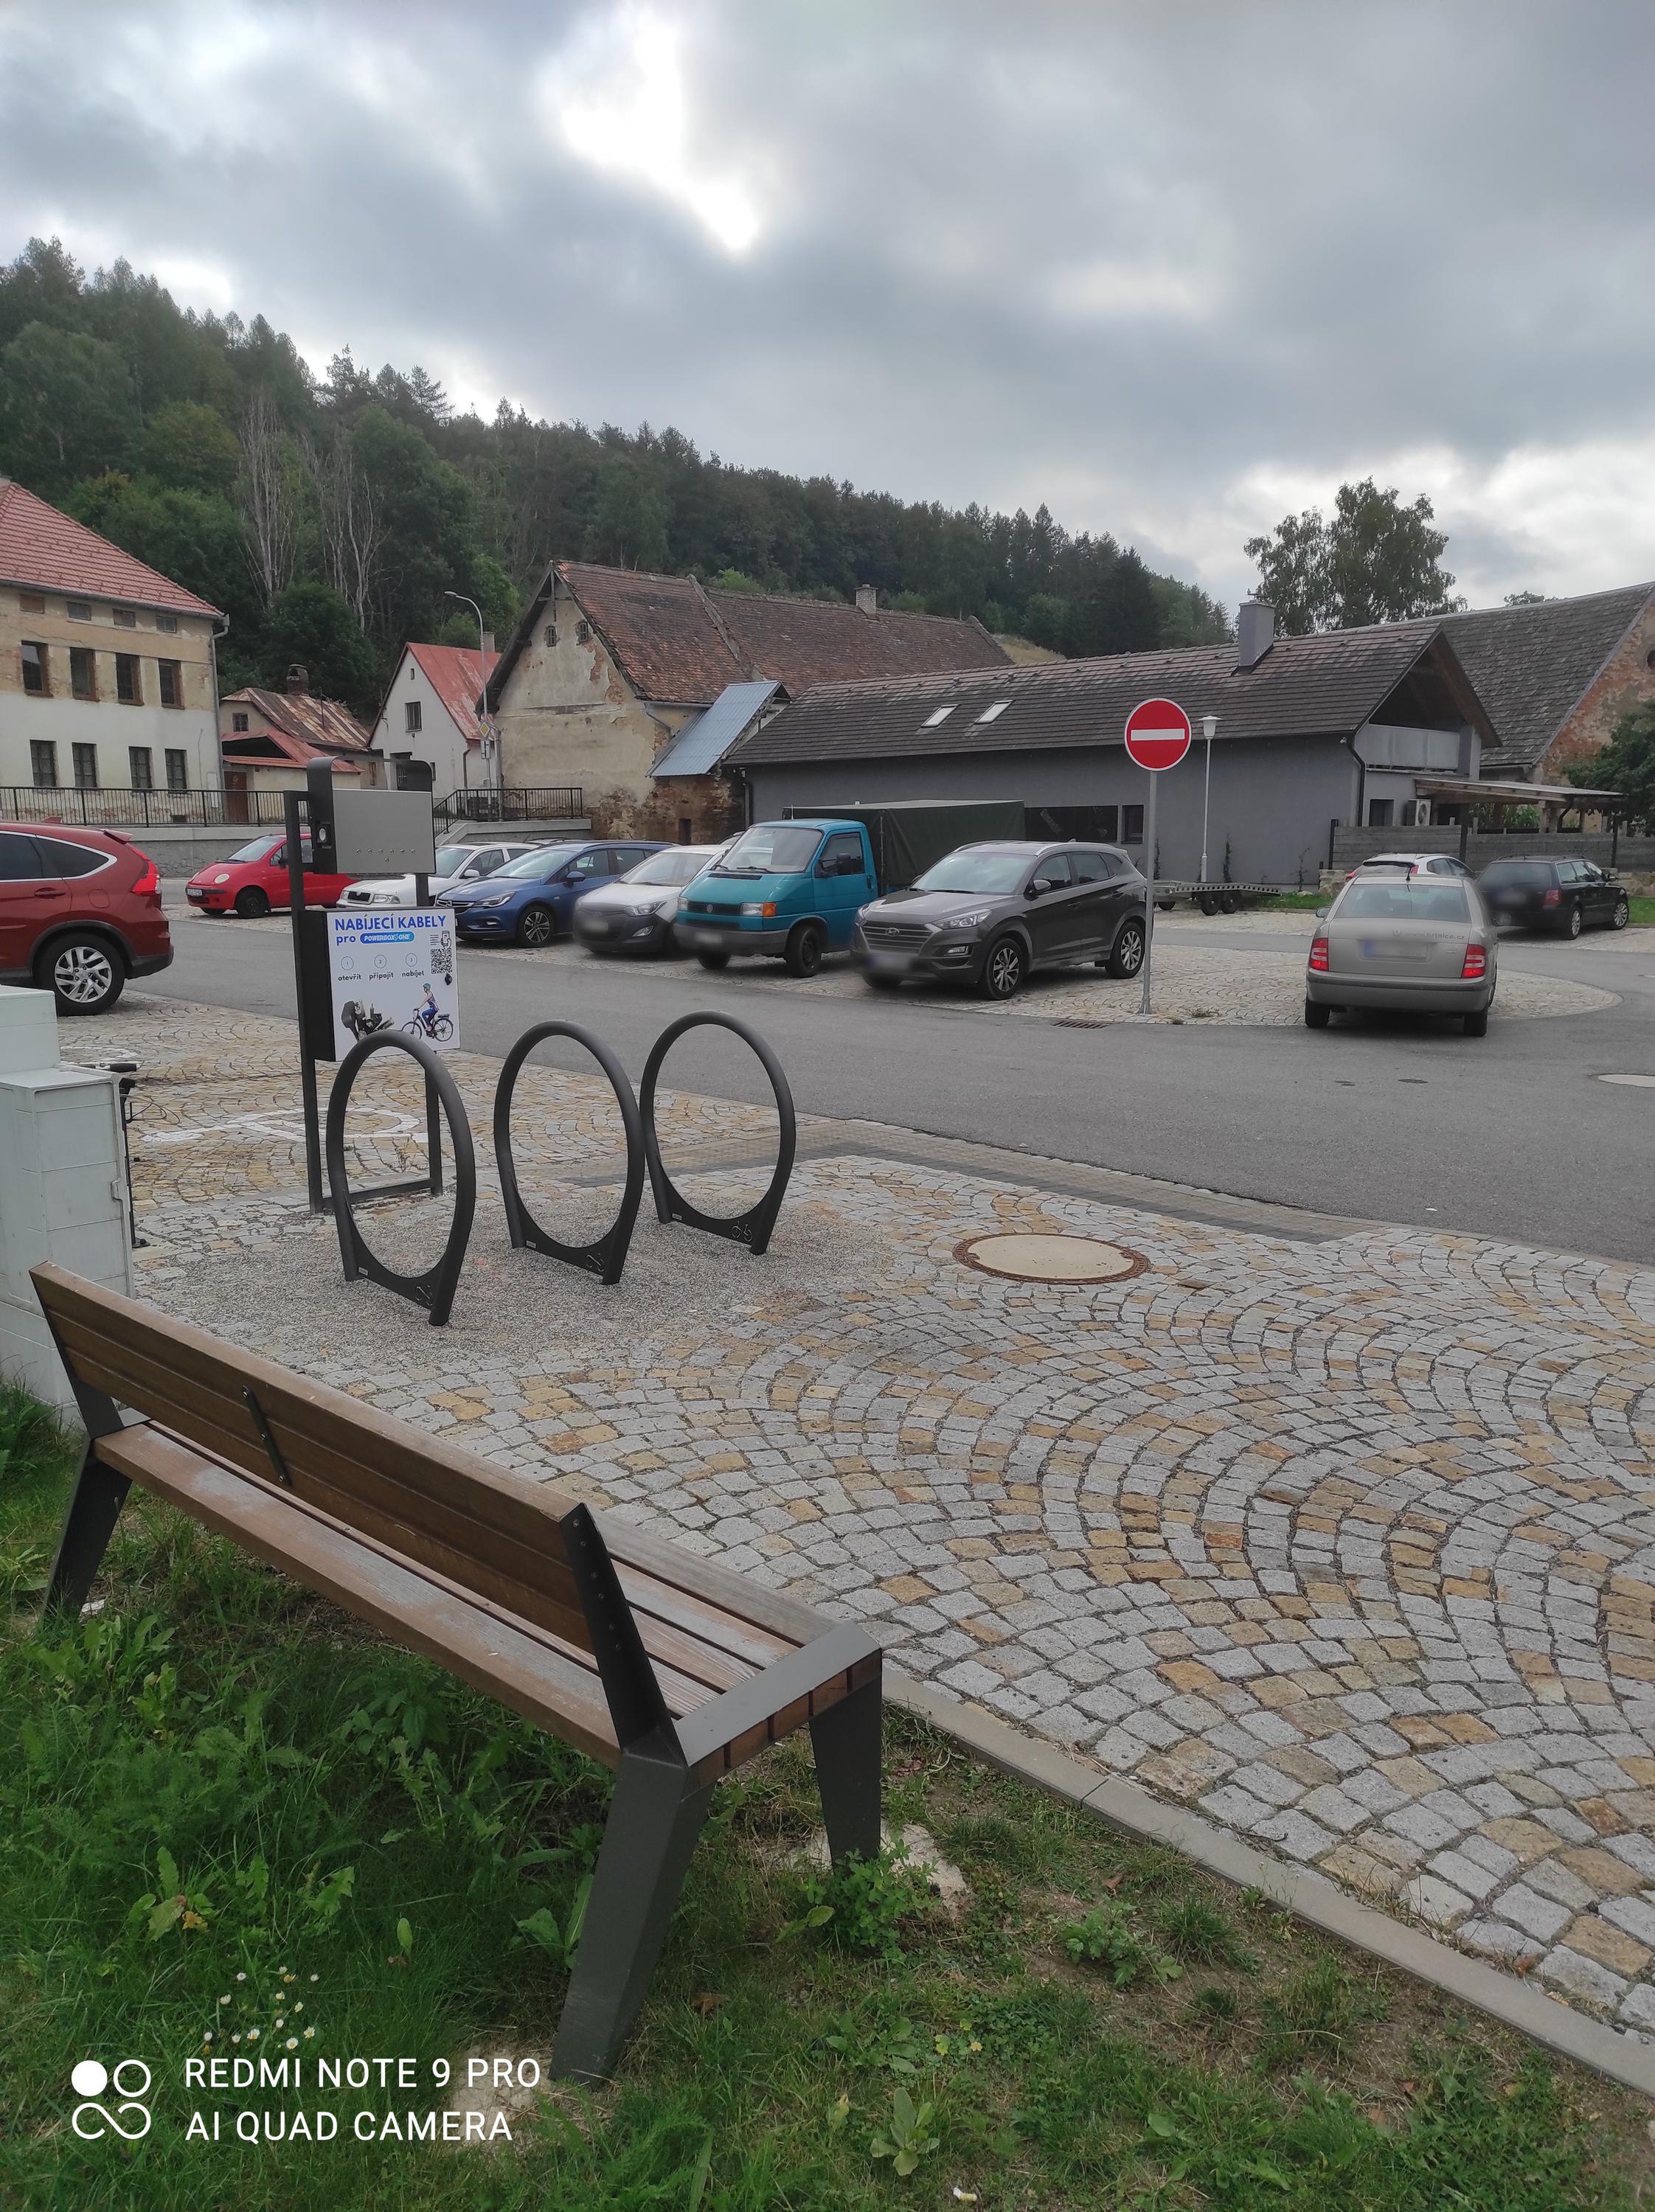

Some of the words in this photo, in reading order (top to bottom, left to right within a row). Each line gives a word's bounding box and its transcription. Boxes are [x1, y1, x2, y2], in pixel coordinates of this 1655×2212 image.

[335, 913, 394, 931] NABÍJECÍ
[398, 915, 447, 929] KABELY
[336, 935, 356, 946] pro
[369, 971, 394, 981] připojit
